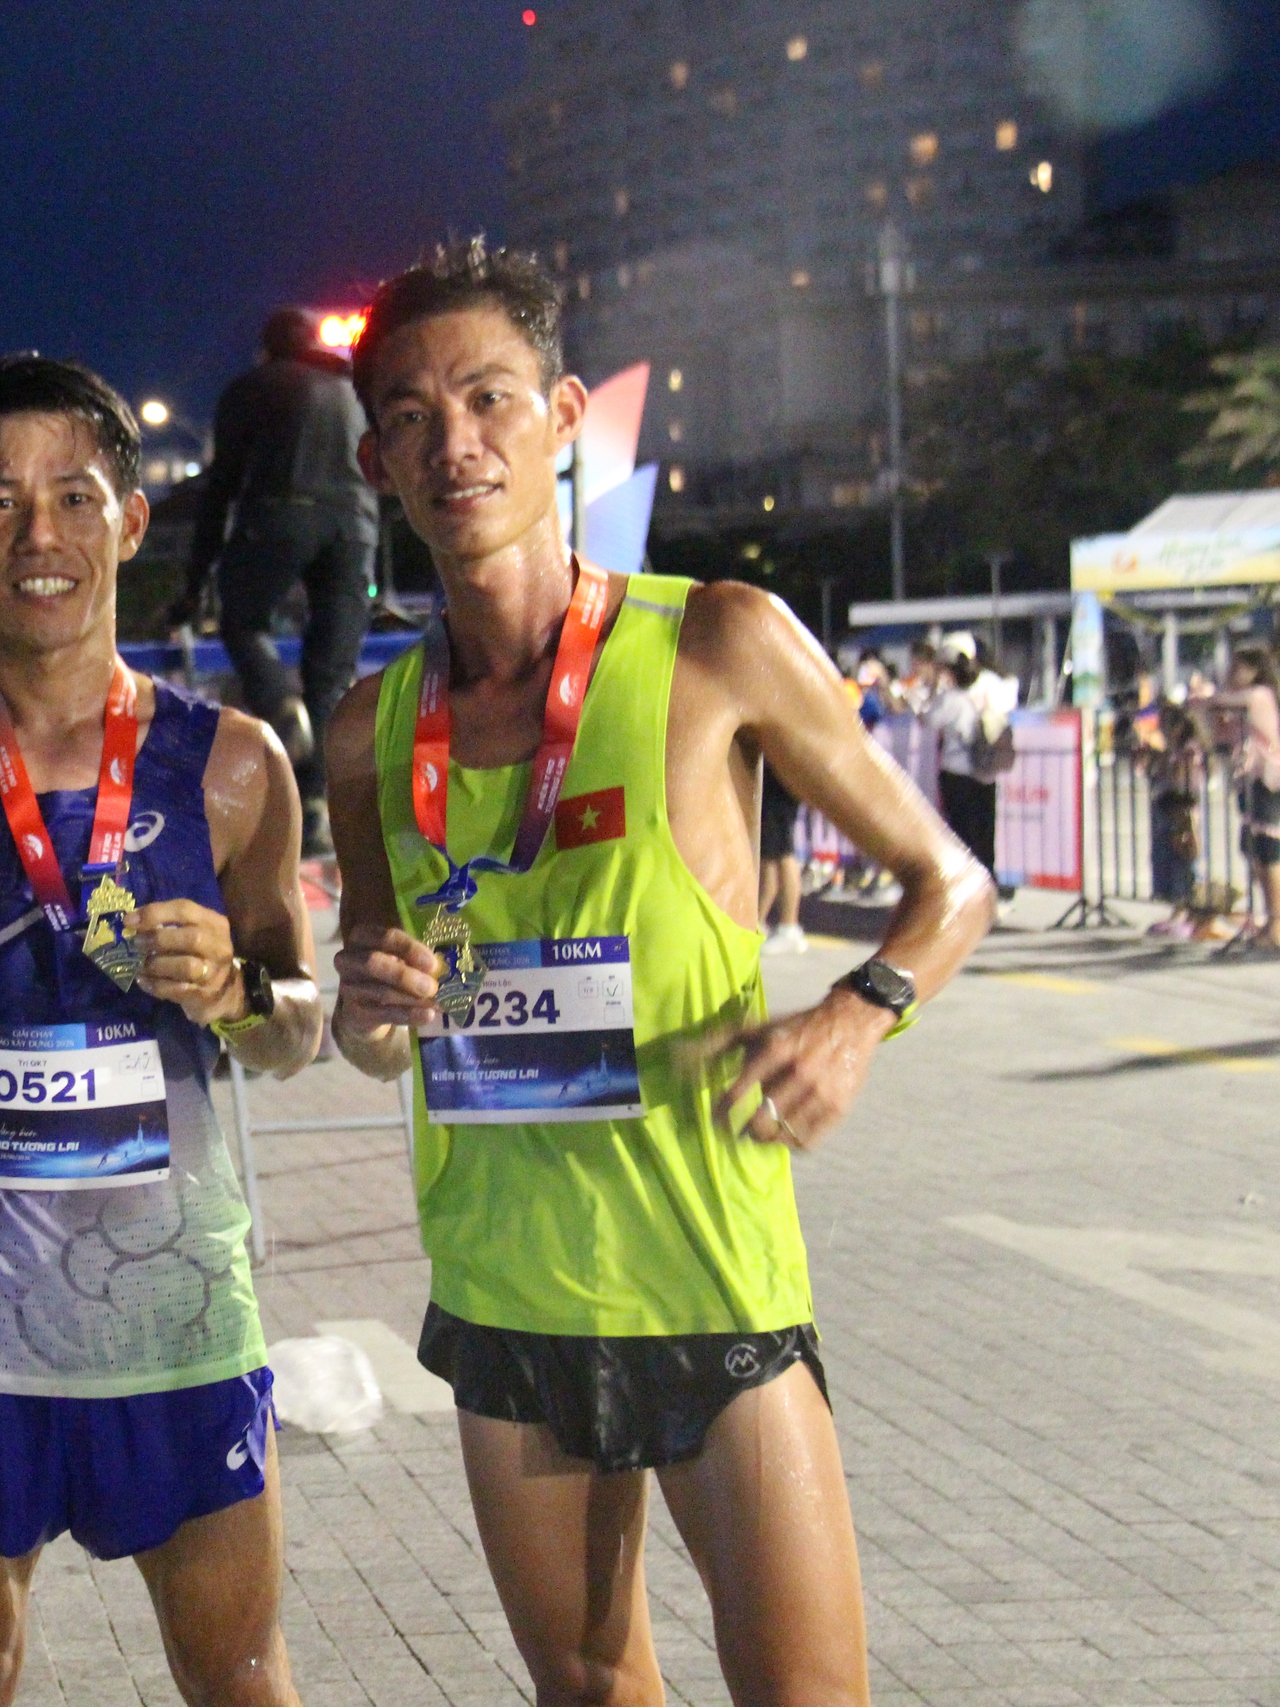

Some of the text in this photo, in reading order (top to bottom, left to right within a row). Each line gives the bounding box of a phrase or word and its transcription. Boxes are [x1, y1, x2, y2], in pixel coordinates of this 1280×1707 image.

[552, 942, 602, 960] 10KM
[96, 1023, 137, 1042] 10KM
[519, 1068, 539, 1079] LAI
[58, 1141, 80, 1152] LAI
